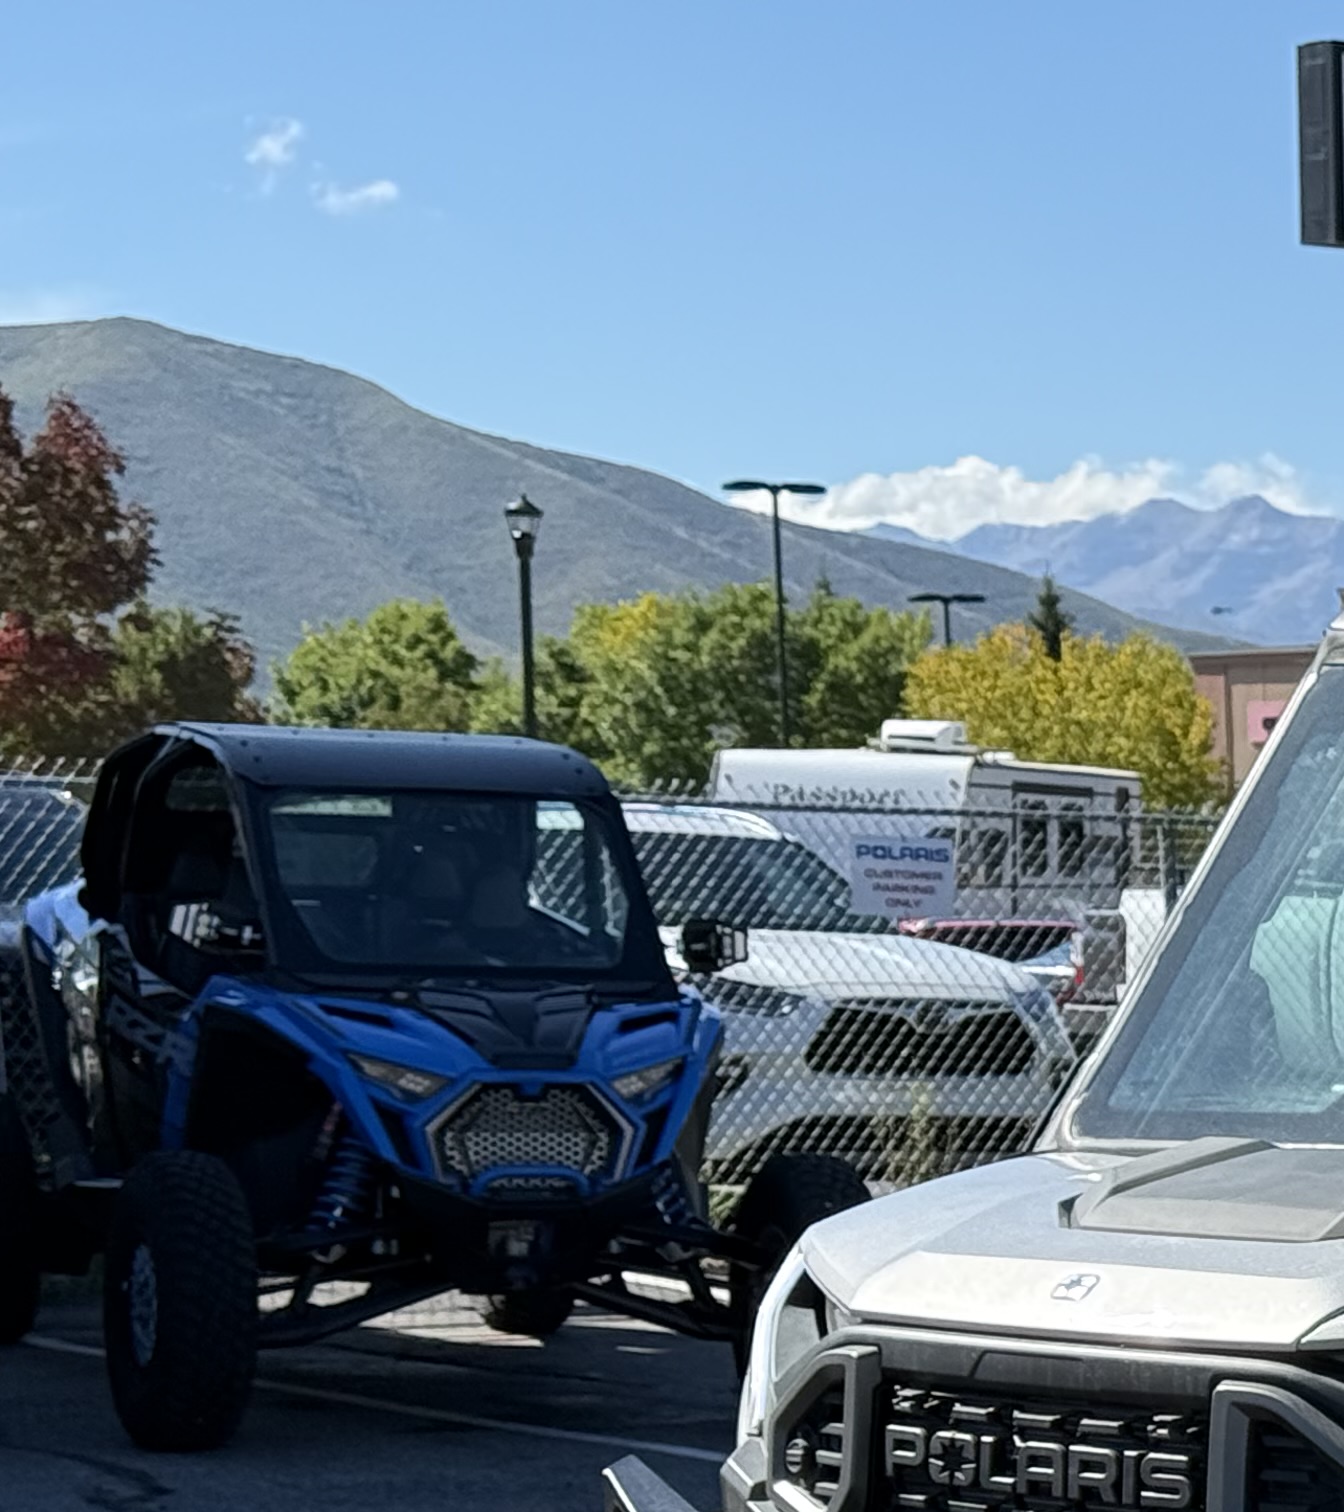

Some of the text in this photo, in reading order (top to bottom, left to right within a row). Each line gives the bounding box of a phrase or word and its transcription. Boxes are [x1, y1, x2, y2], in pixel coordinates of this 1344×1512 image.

[856, 845, 950, 863] POLARIS
[863, 868, 943, 880] CUSTOMER
[872, 882, 936, 896] PARKING
[884, 897, 922, 908] ONLY
[885, 1424, 1192, 1509] POLARIS
